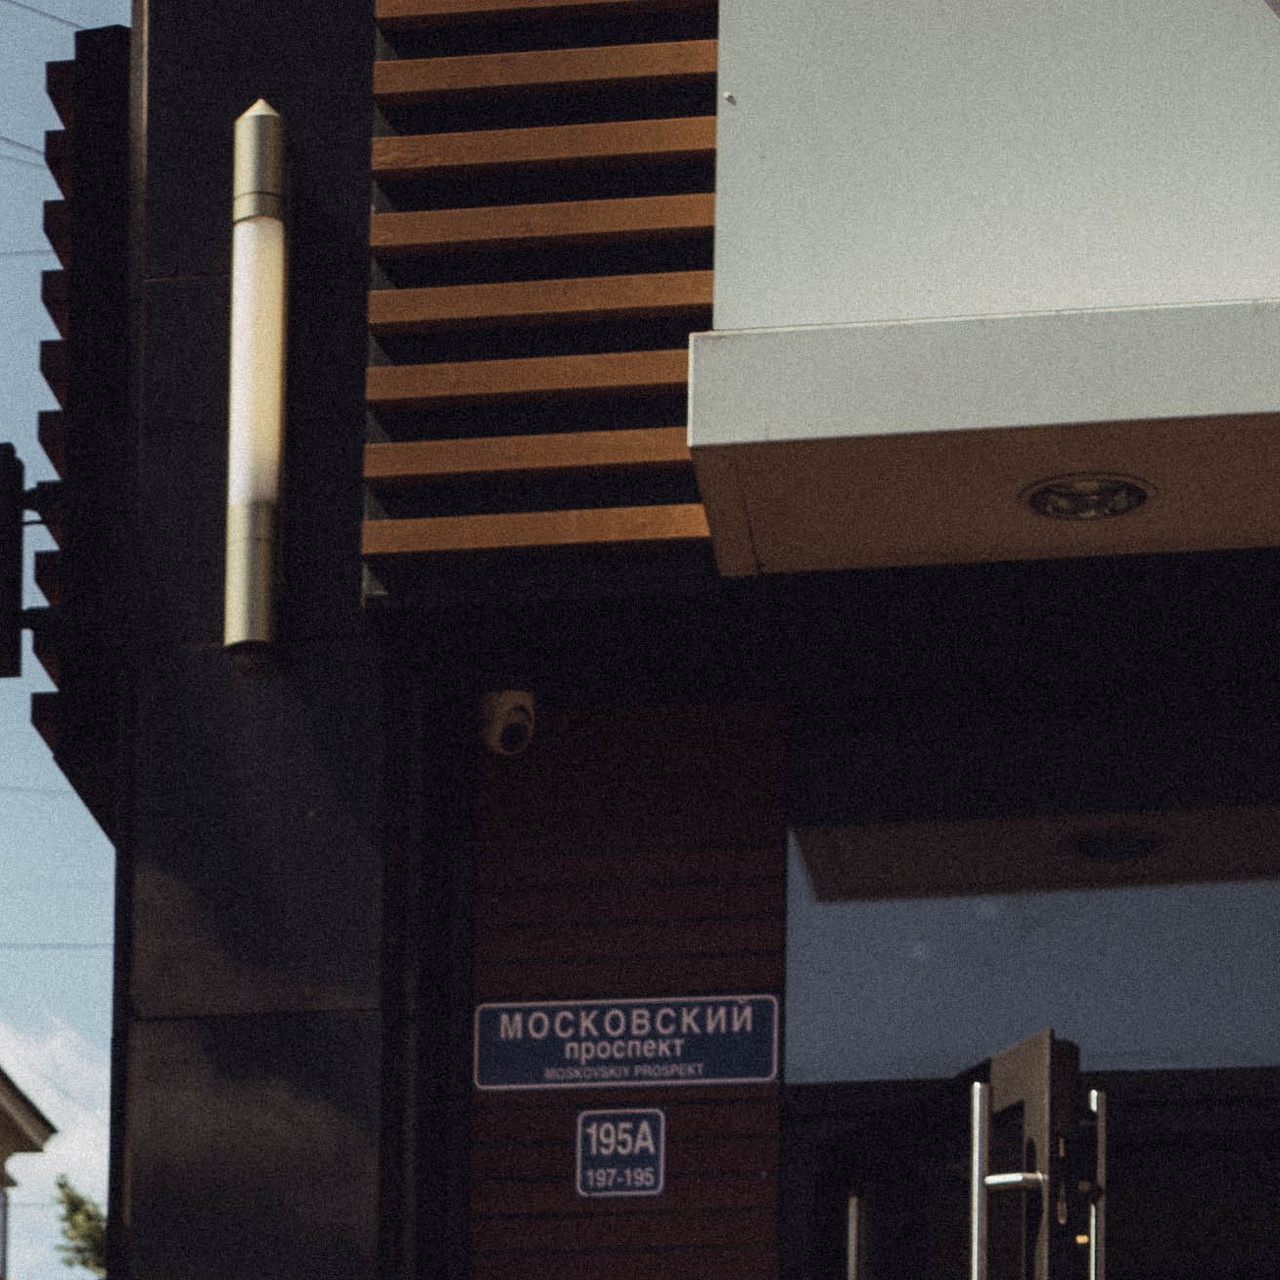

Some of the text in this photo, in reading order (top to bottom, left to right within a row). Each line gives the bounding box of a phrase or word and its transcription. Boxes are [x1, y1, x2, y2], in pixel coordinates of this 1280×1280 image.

[499, 1000, 754, 1040] МОСКОВСКИЙ
[565, 1038, 685, 1064] проспект
[634, 1062, 705, 1077] PROSPEKT
[586, 1167, 655, 1188] 197-195
